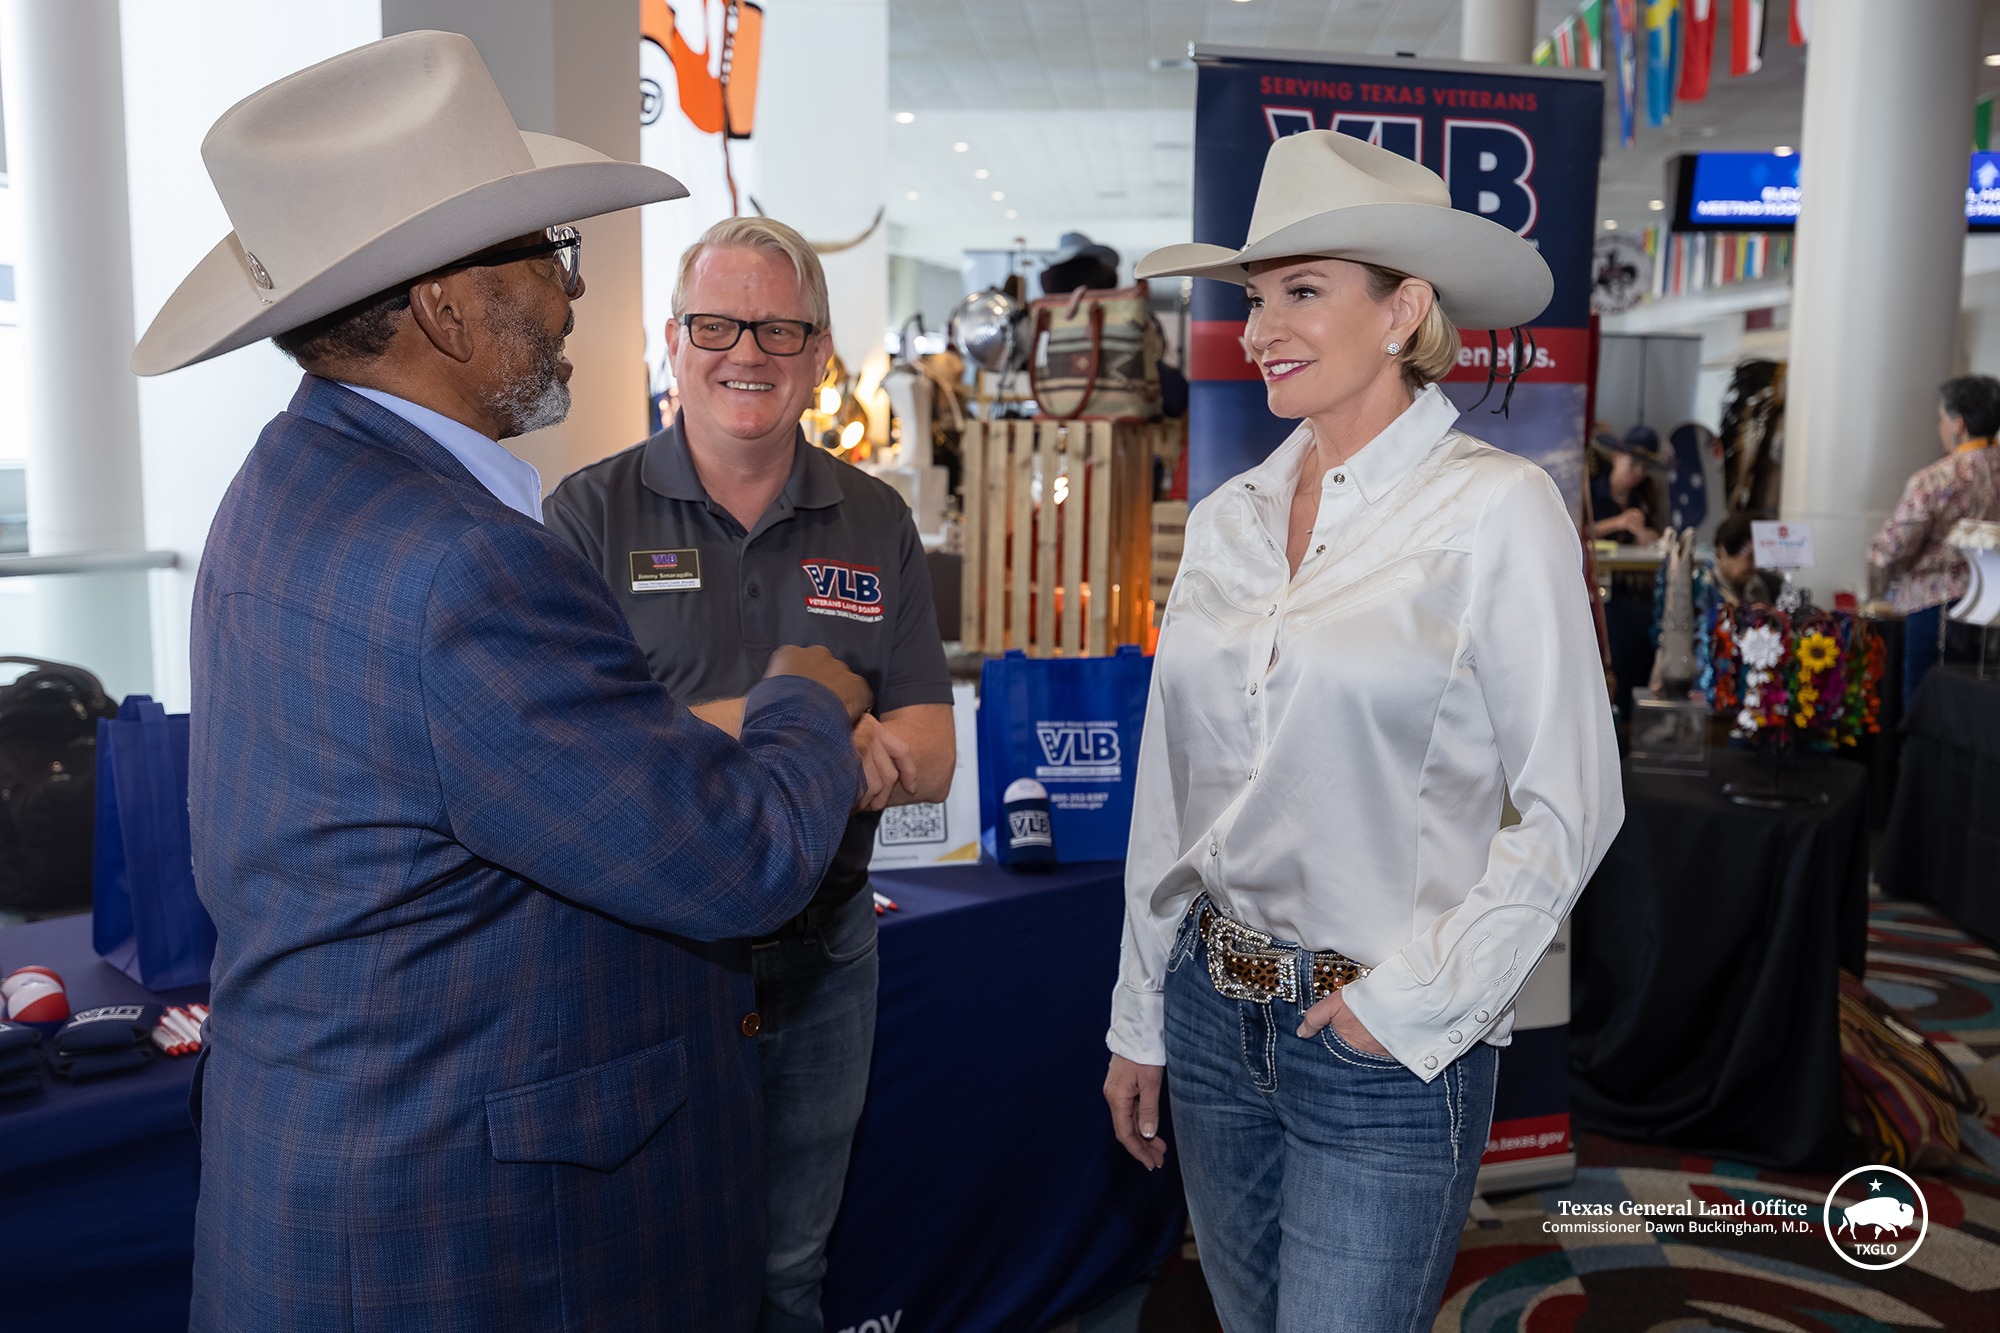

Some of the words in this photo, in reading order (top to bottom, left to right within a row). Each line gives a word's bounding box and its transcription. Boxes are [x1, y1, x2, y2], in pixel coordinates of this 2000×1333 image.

[1260, 76, 1353, 100] SERVING
[1361, 83, 1426, 105] TEXAS
[1433, 87, 1538, 111] VETERANS
[1457, 341, 1556, 369] enefts.
[651, 554, 677, 564] VLB
[802, 565, 882, 604] VLB
[809, 598, 841, 608] VETERANS
[842, 602, 858, 612] LAND
[858, 605, 881, 614] BOARD
[1036, 728, 1121, 766] VLB
[1009, 816, 1051, 837] VLB
[1487, 1131, 1566, 1153] o.texas.gov
[837, 1308, 903, 1333] ov
